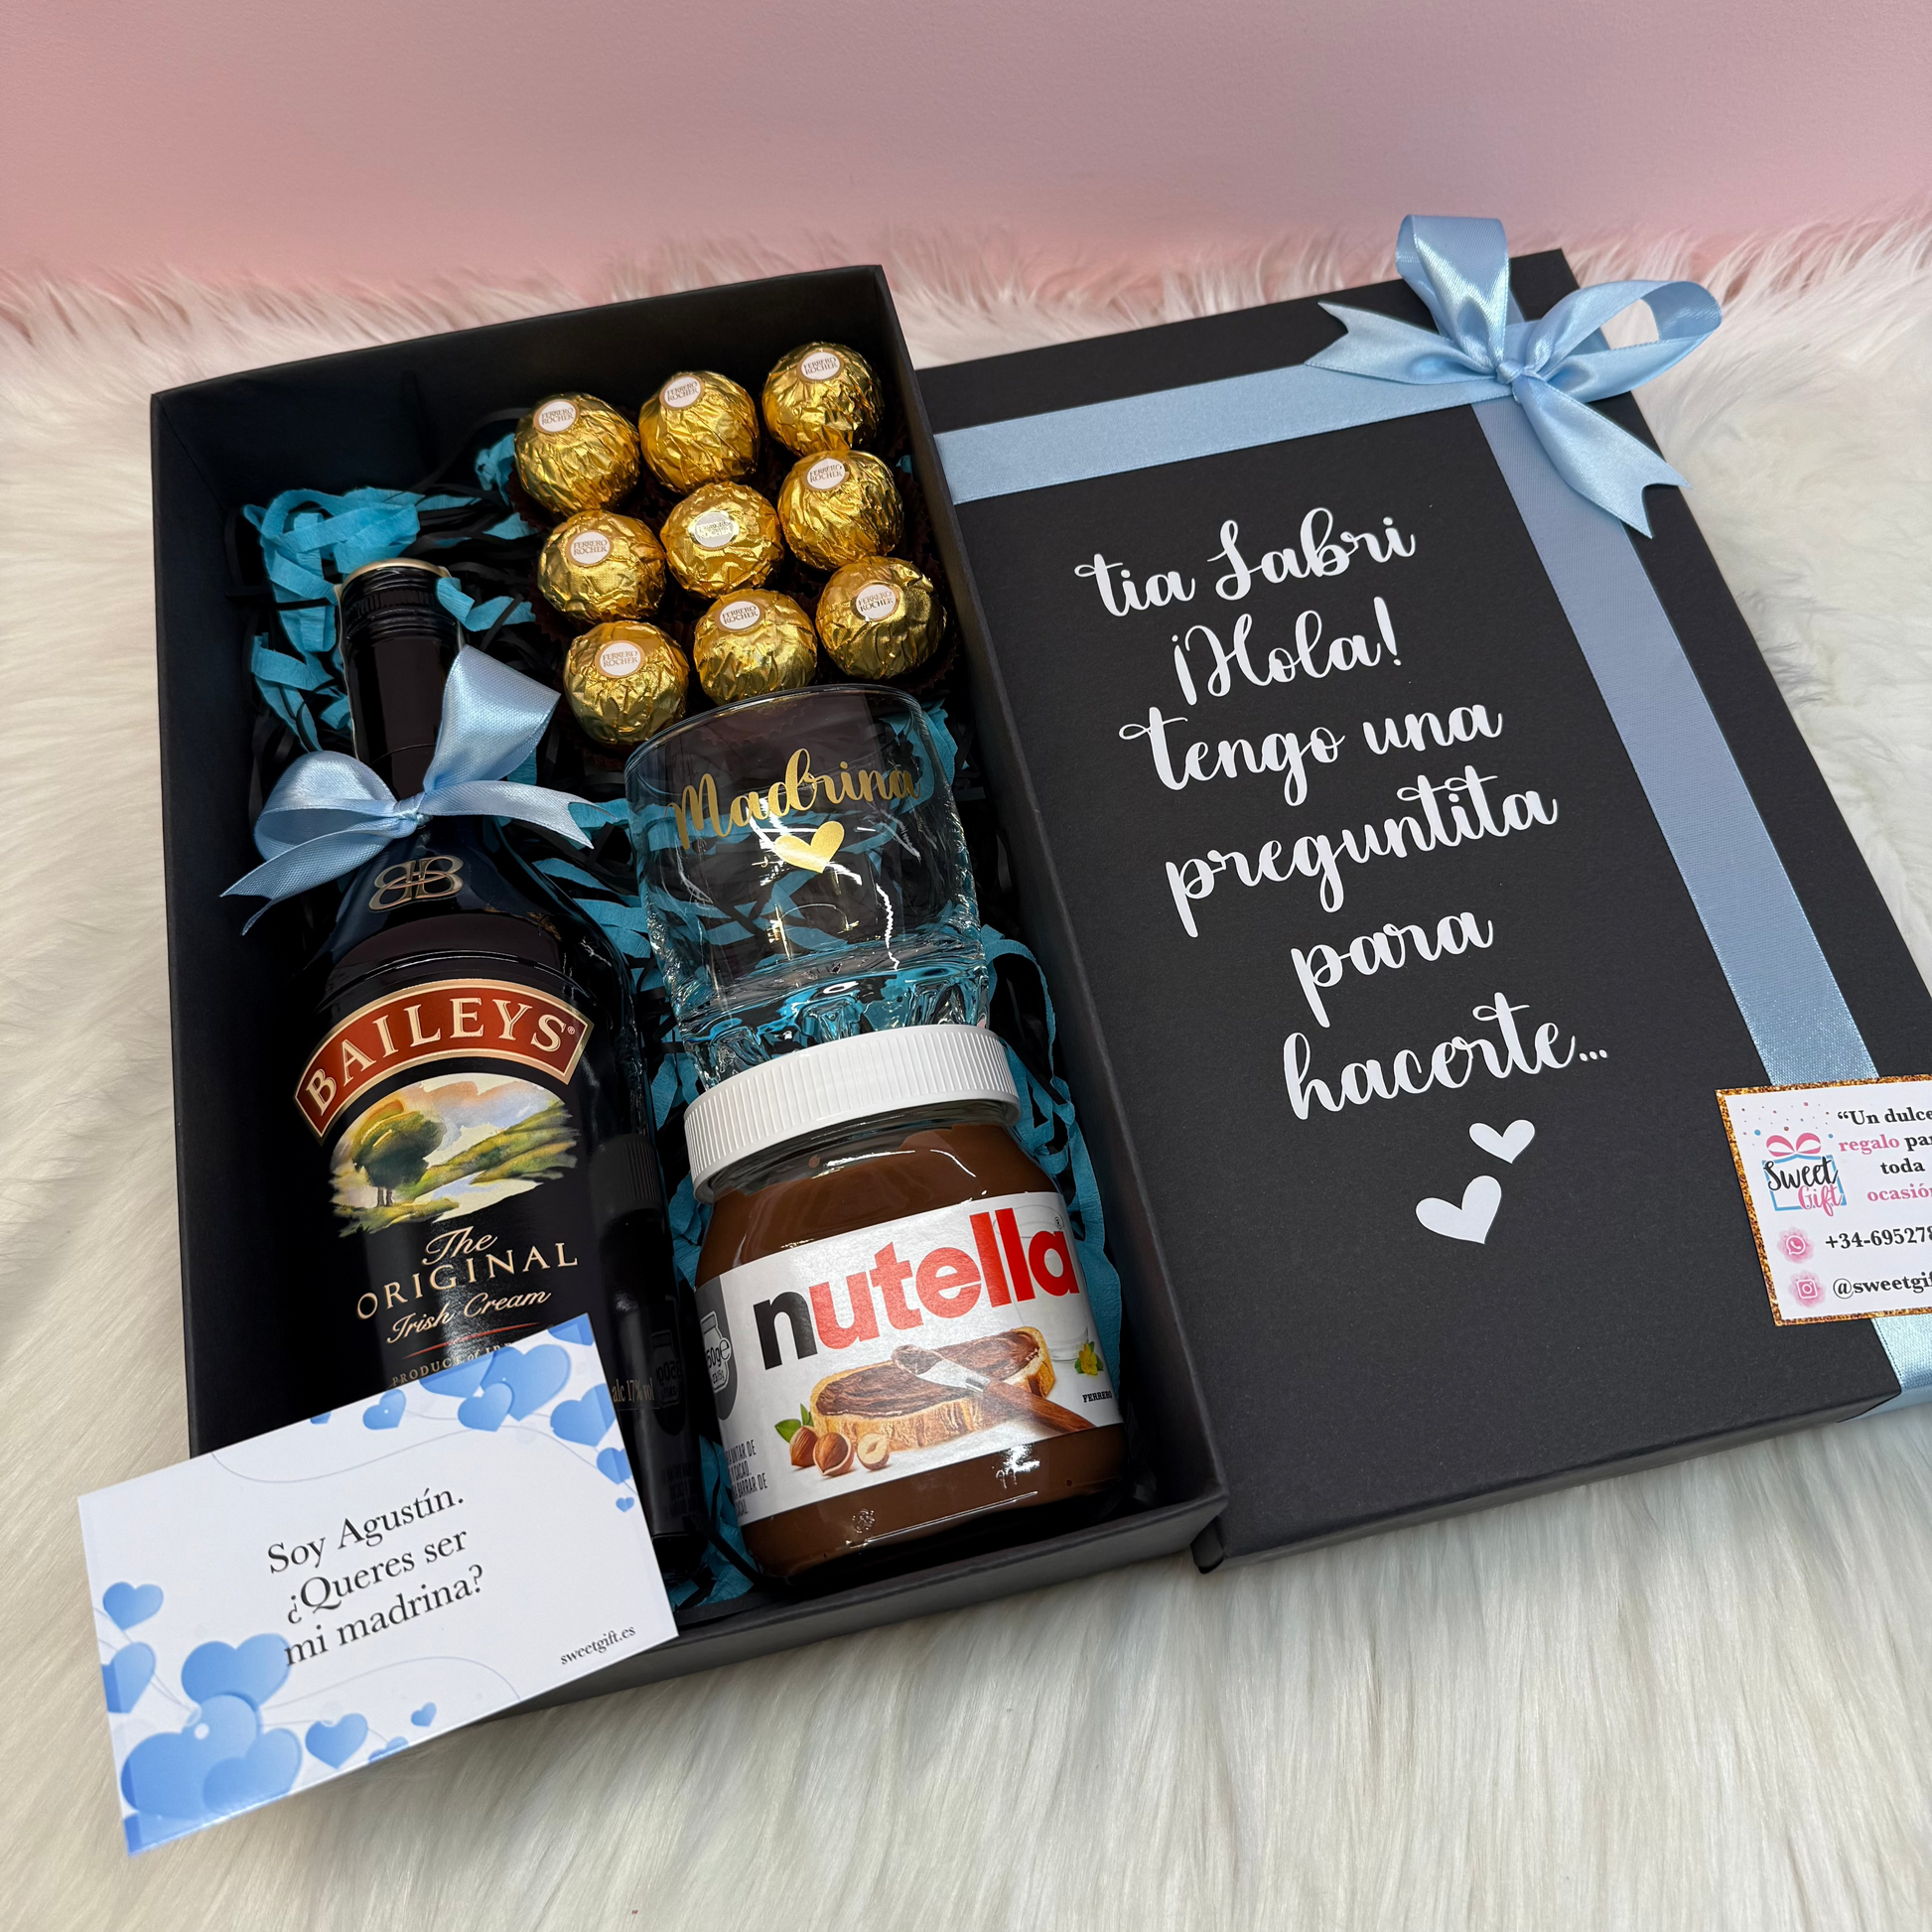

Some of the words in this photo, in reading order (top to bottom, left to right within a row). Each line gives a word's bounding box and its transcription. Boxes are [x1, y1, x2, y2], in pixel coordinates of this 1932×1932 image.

[803, 356, 836, 369] FERRERO
[805, 363, 838, 375] ROCHER
[667, 381, 698, 394] FERRERO
[667, 388, 698, 401] ROCHER
[541, 408, 574, 418] FERRERO
[541, 414, 574, 425] ROCHER
[809, 465, 842, 477] FERRERO
[809, 471, 843, 483] ROCHER
[574, 540, 609, 549] FERRERO
[574, 546, 608, 556] ROCHER
[1074, 553, 1195, 617] tia
[858, 591, 893, 606] FERRERO
[860, 599, 895, 612] ROCHER
[722, 606, 757, 619] FERRERO
[723, 612, 758, 624] ROCHER
[602, 650, 638, 660] FERRERO
[1171, 596, 1402, 705] ¡Hola!
[603, 657, 638, 667] ROCHER
[1118, 706, 1345, 806] tengo
[1362, 704, 1503, 755] una
[664, 749, 920, 850] Madrina
[1165, 764, 1558, 938] preguntita
[1291, 911, 1493, 1029] para
[1283, 992, 1608, 1120] hacerte...
[1839, 1134, 1900, 1156] regalo
[1764, 1157, 1839, 1191] Sweet
[1880, 1158, 1926, 1174] toda
[1798, 1182, 1843, 1217] Gift
[422, 1226, 497, 1266] The
[356, 1242, 579, 1320] ORIGINAL
[753, 1207, 1080, 1371] nutella
[386, 1309, 455, 1344] Irish
[464, 1291, 551, 1319] Cream
[612, 1378, 625, 1403] alc
[625, 1378, 643, 1402] 17%
[643, 1377, 655, 1401] vol
[1082, 1391, 1113, 1403] FERRERO
[747, 1439, 757, 1457] DE
[758, 1472, 768, 1490] DE
[267, 1535, 327, 1574] Soy
[337, 1488, 465, 1550] Agustín.
[287, 1547, 416, 1625] ¿Queres
[424, 1529, 468, 1564] ser
[284, 1624, 329, 1667] mi
[337, 1563, 484, 1648] madrina?
[559, 1624, 636, 1666] sweetgift.es
